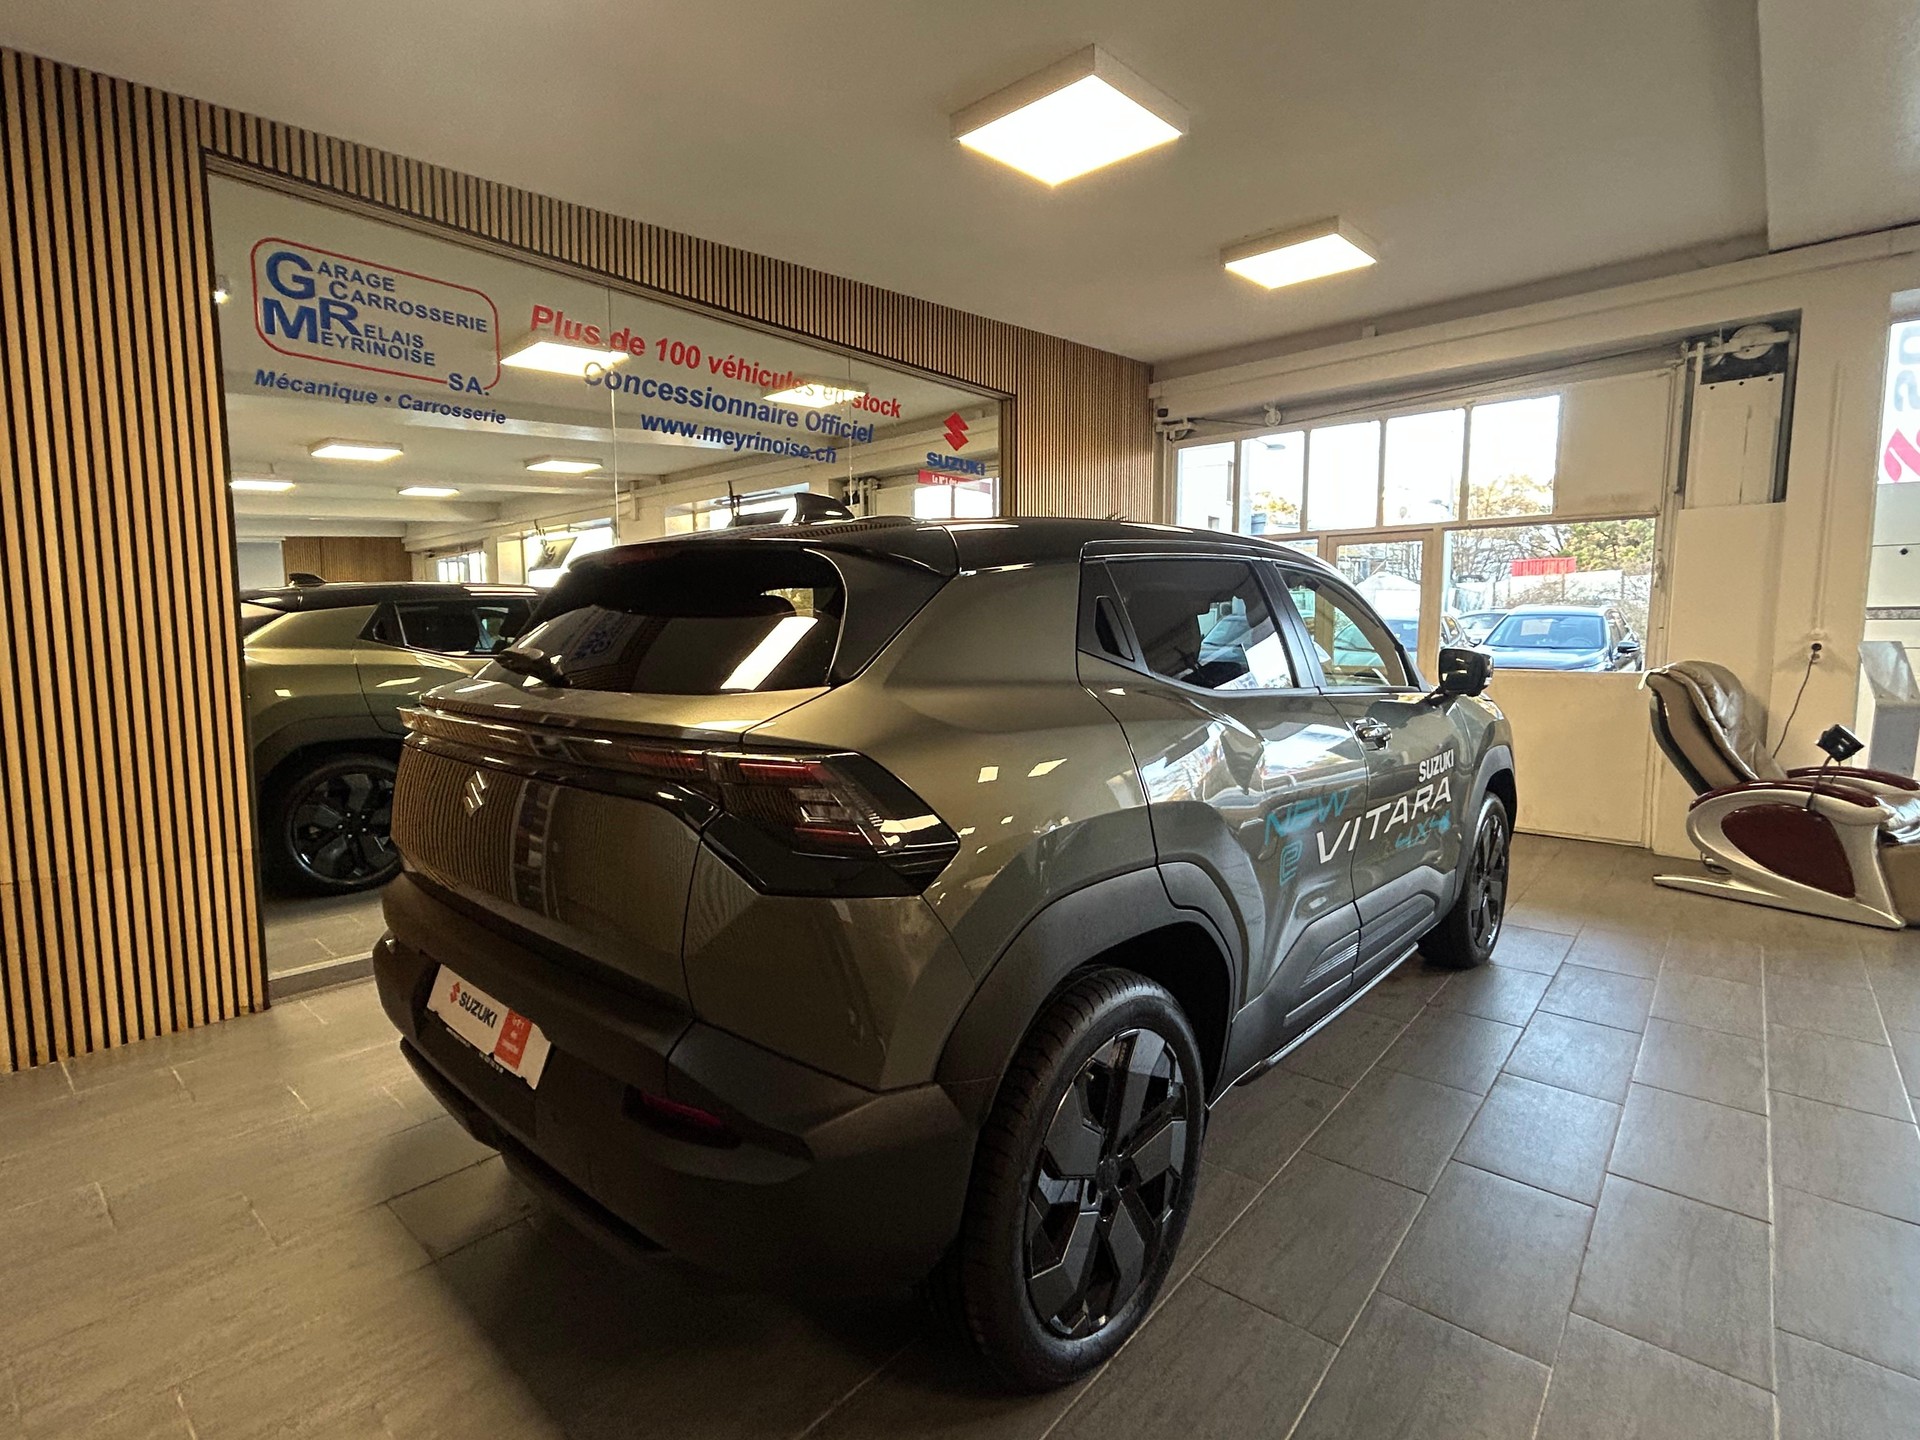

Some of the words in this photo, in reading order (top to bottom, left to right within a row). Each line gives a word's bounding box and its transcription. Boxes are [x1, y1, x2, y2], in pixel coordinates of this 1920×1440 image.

[265, 251, 395, 300] GARAGE
[263, 297, 436, 366] MEYRINOISE
[319, 297, 424, 350] RELAIS
[328, 280, 488, 333] CARROSSERIE
[530, 304, 601, 347] Plus
[610, 327, 646, 356] de
[655, 338, 701, 369] 100
[708, 353, 815, 396] véhicules
[823, 384, 846, 405] en
[851, 391, 902, 418] stock
[255, 369, 378, 404] Mécanique
[398, 394, 506, 424] Carrosserie
[584, 361, 799, 428] Concessionnaire
[805, 410, 874, 443] Officiel
[640, 413, 837, 464] www.meyrinoise.ch
[926, 451, 986, 476] SUZUKI
[1418, 748, 1455, 783] SUZUKI
[1264, 786, 1352, 848] NEW
[1316, 776, 1453, 865] VITARA
[458, 991, 498, 1028] SUZUKI
